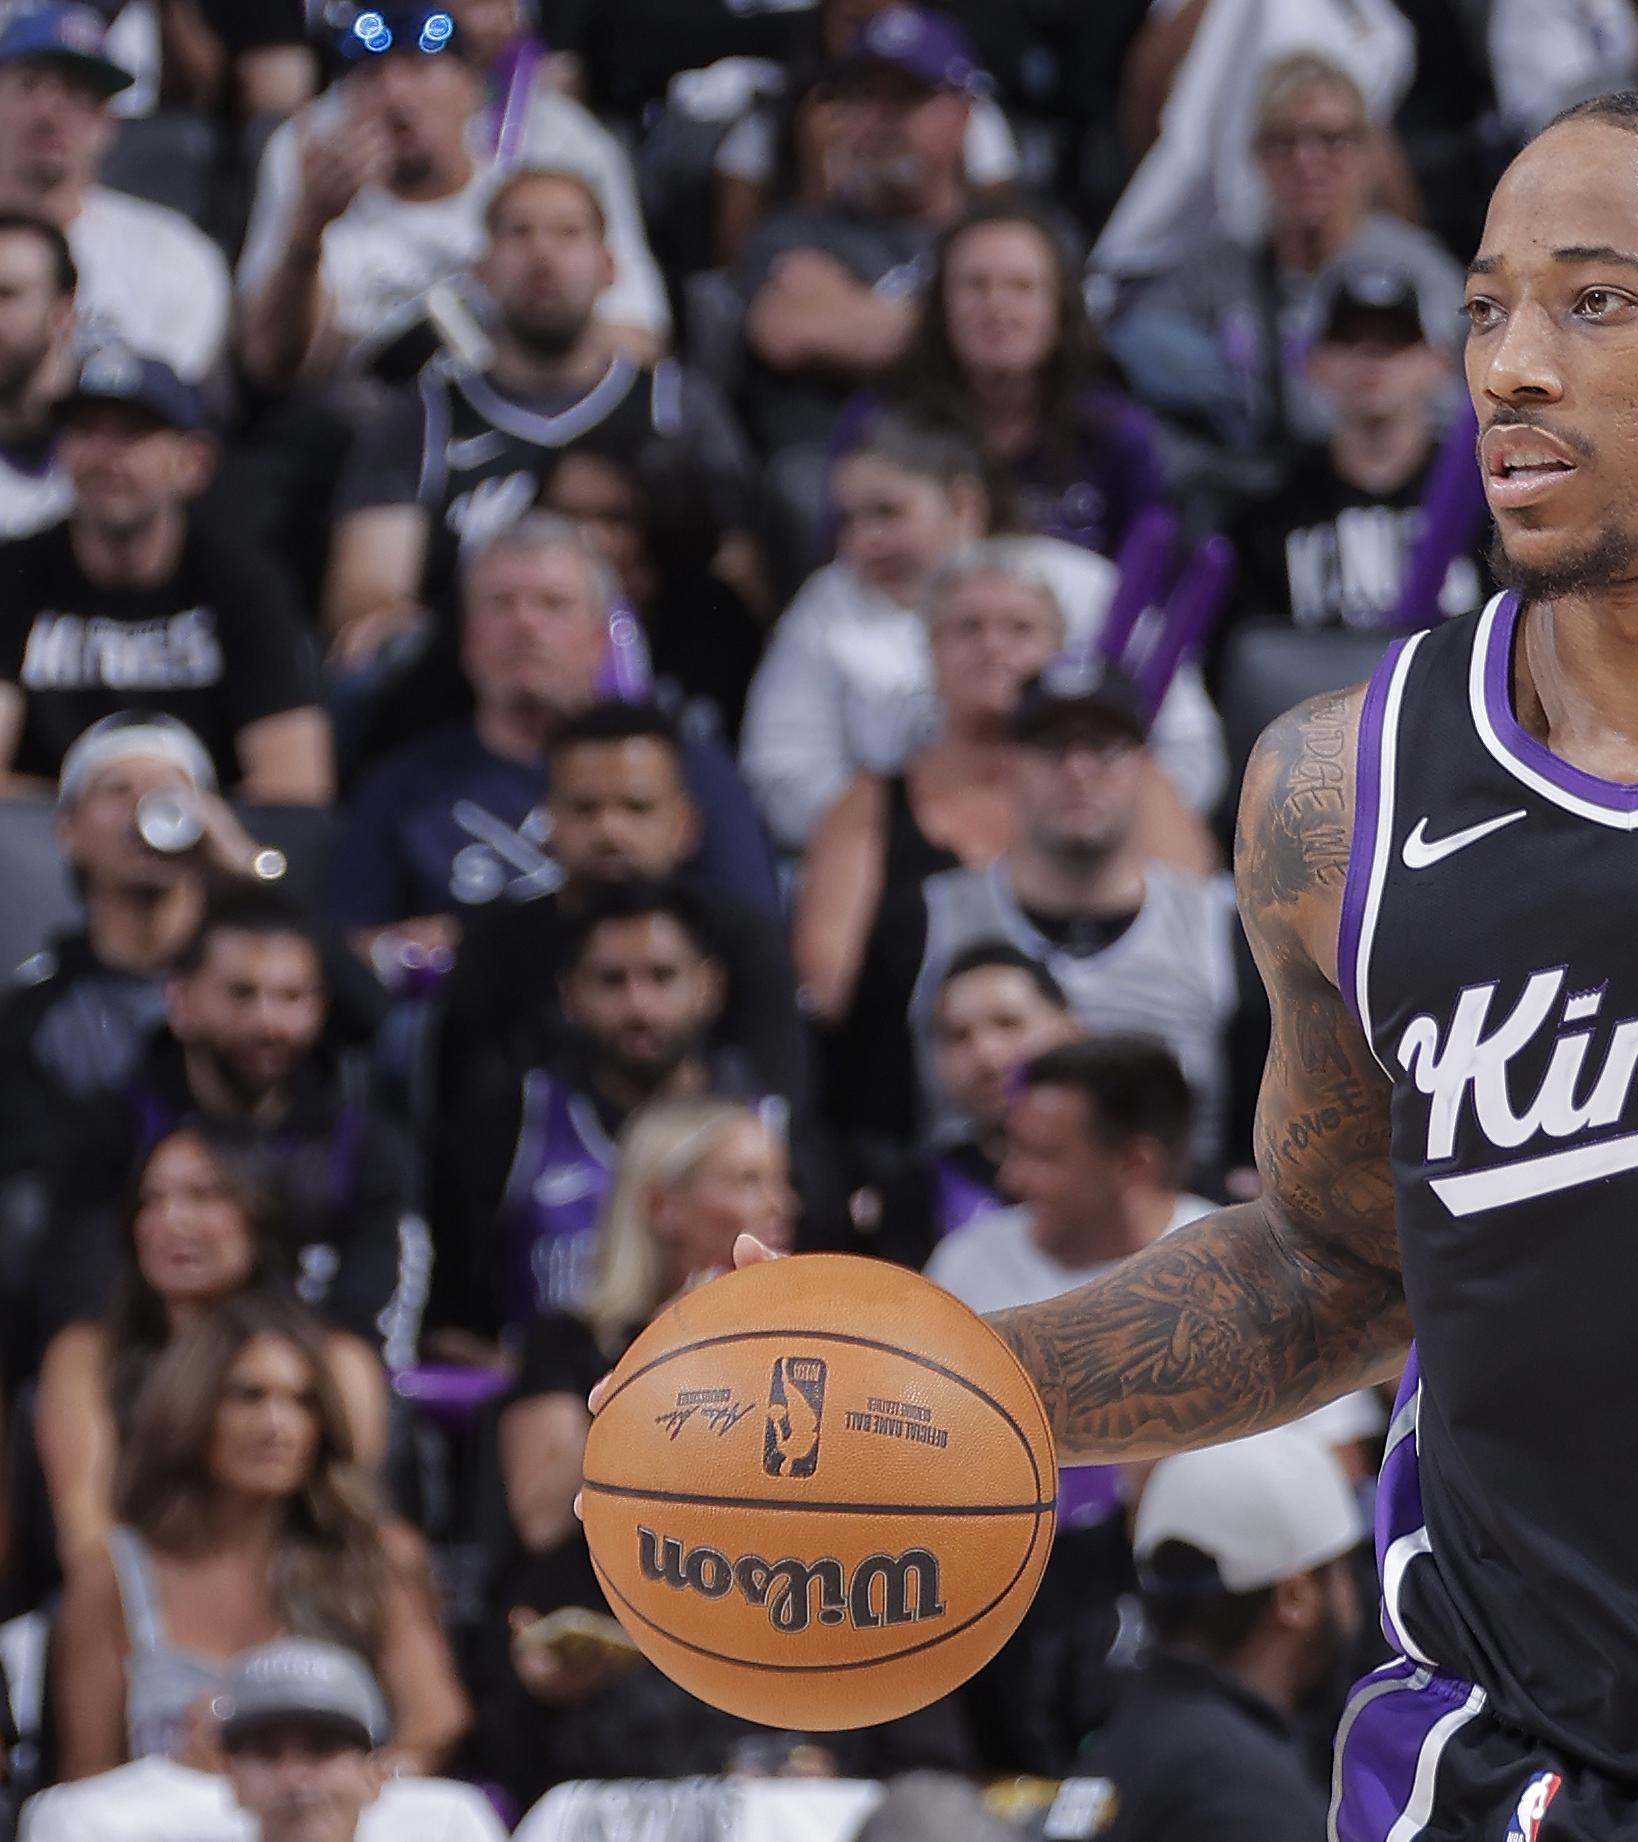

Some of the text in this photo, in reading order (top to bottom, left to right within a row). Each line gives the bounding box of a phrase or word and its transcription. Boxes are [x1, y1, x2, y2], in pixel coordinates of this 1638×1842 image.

[793, 1361, 821, 1382] NBA
[845, 1411, 949, 1449] OFFICIAL GAME BALL
[637, 1524, 946, 1634] Wilson
